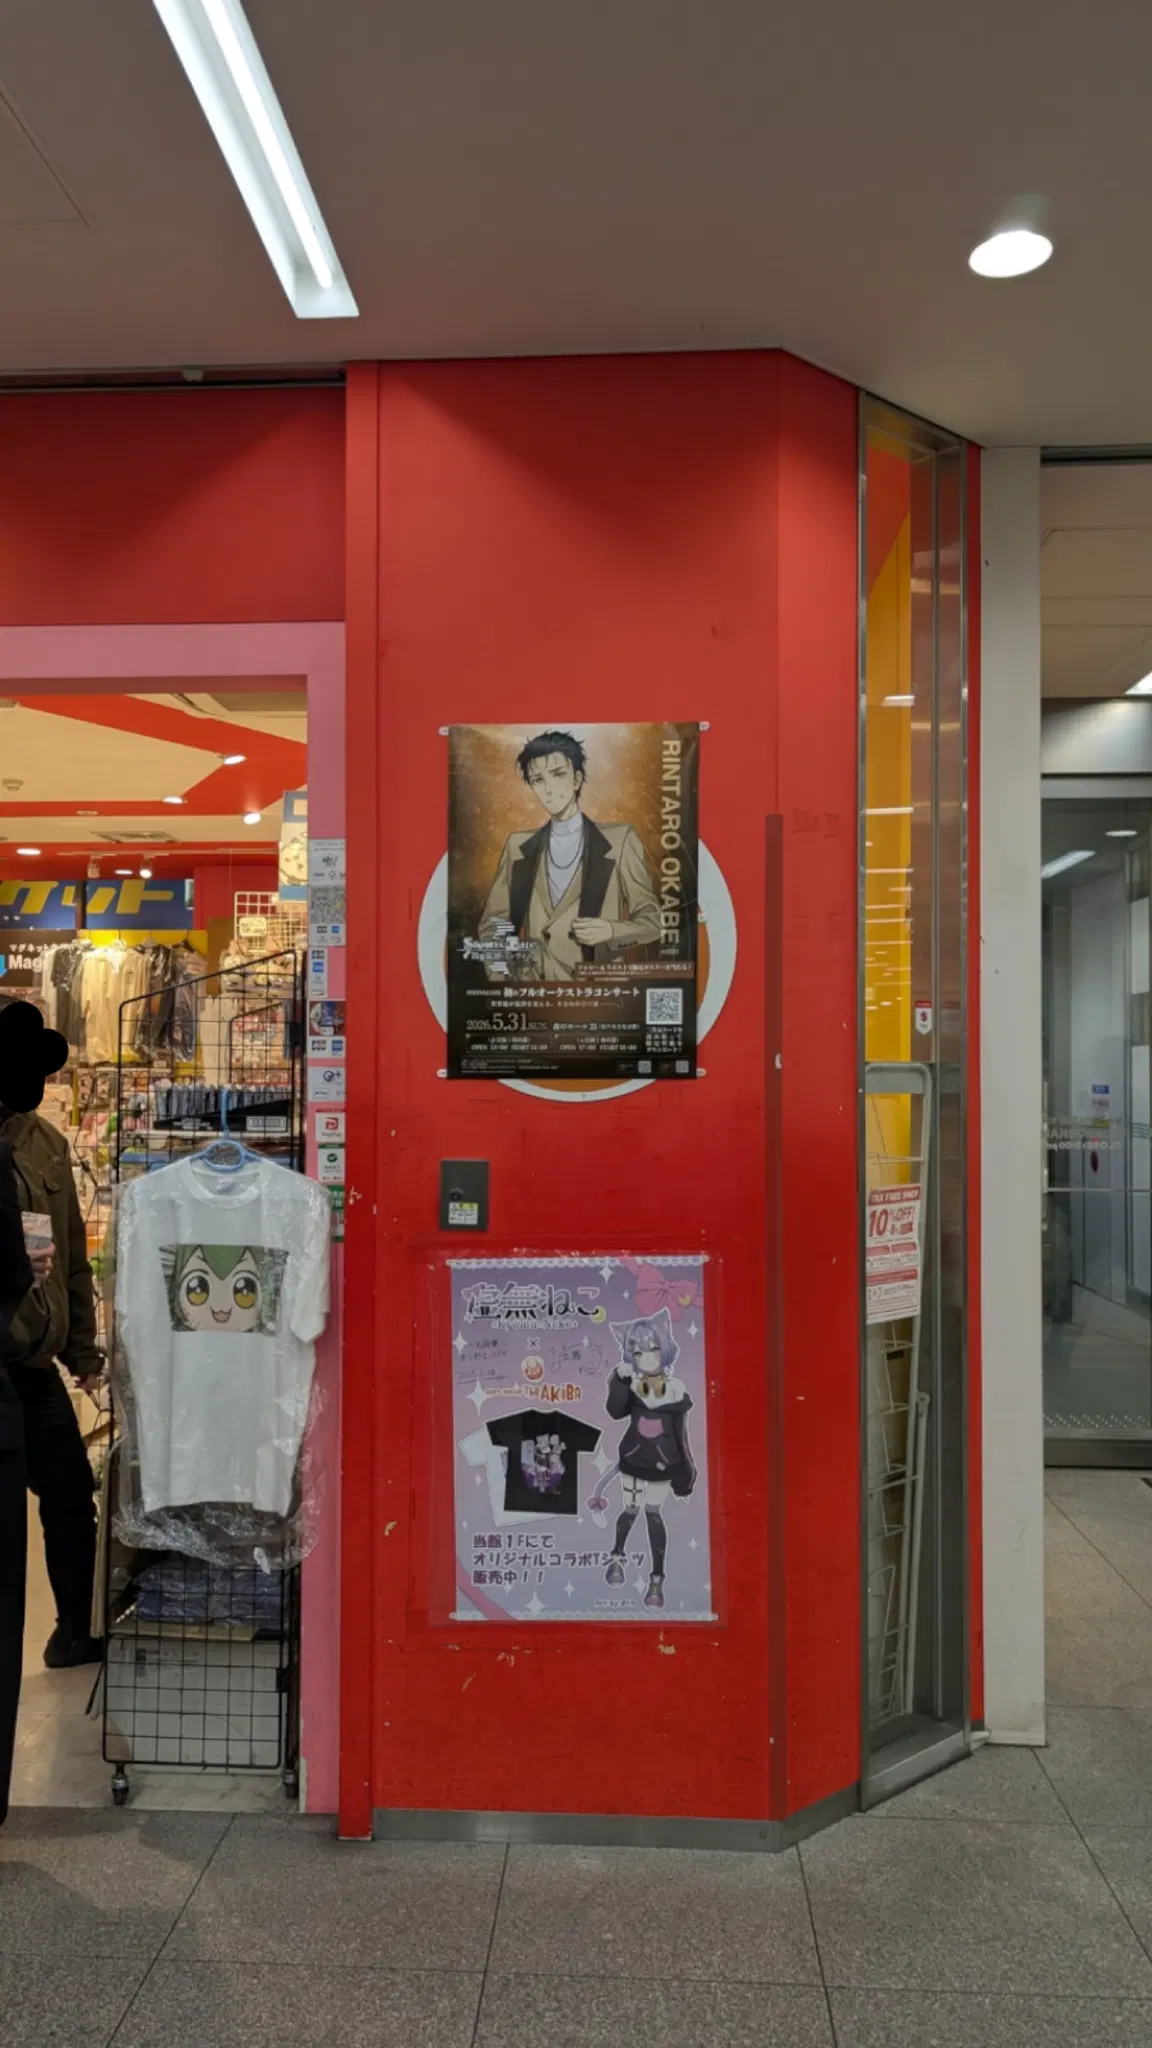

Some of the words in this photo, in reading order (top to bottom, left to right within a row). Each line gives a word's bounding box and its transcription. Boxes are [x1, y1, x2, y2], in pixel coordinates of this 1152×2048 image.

[661, 740, 681, 850] RINTARO
[660, 857, 681, 945] OKABE
[461, 1282, 600, 1322] 虚無ねこ
[473, 1533, 555, 1549] 当館1Fにて
